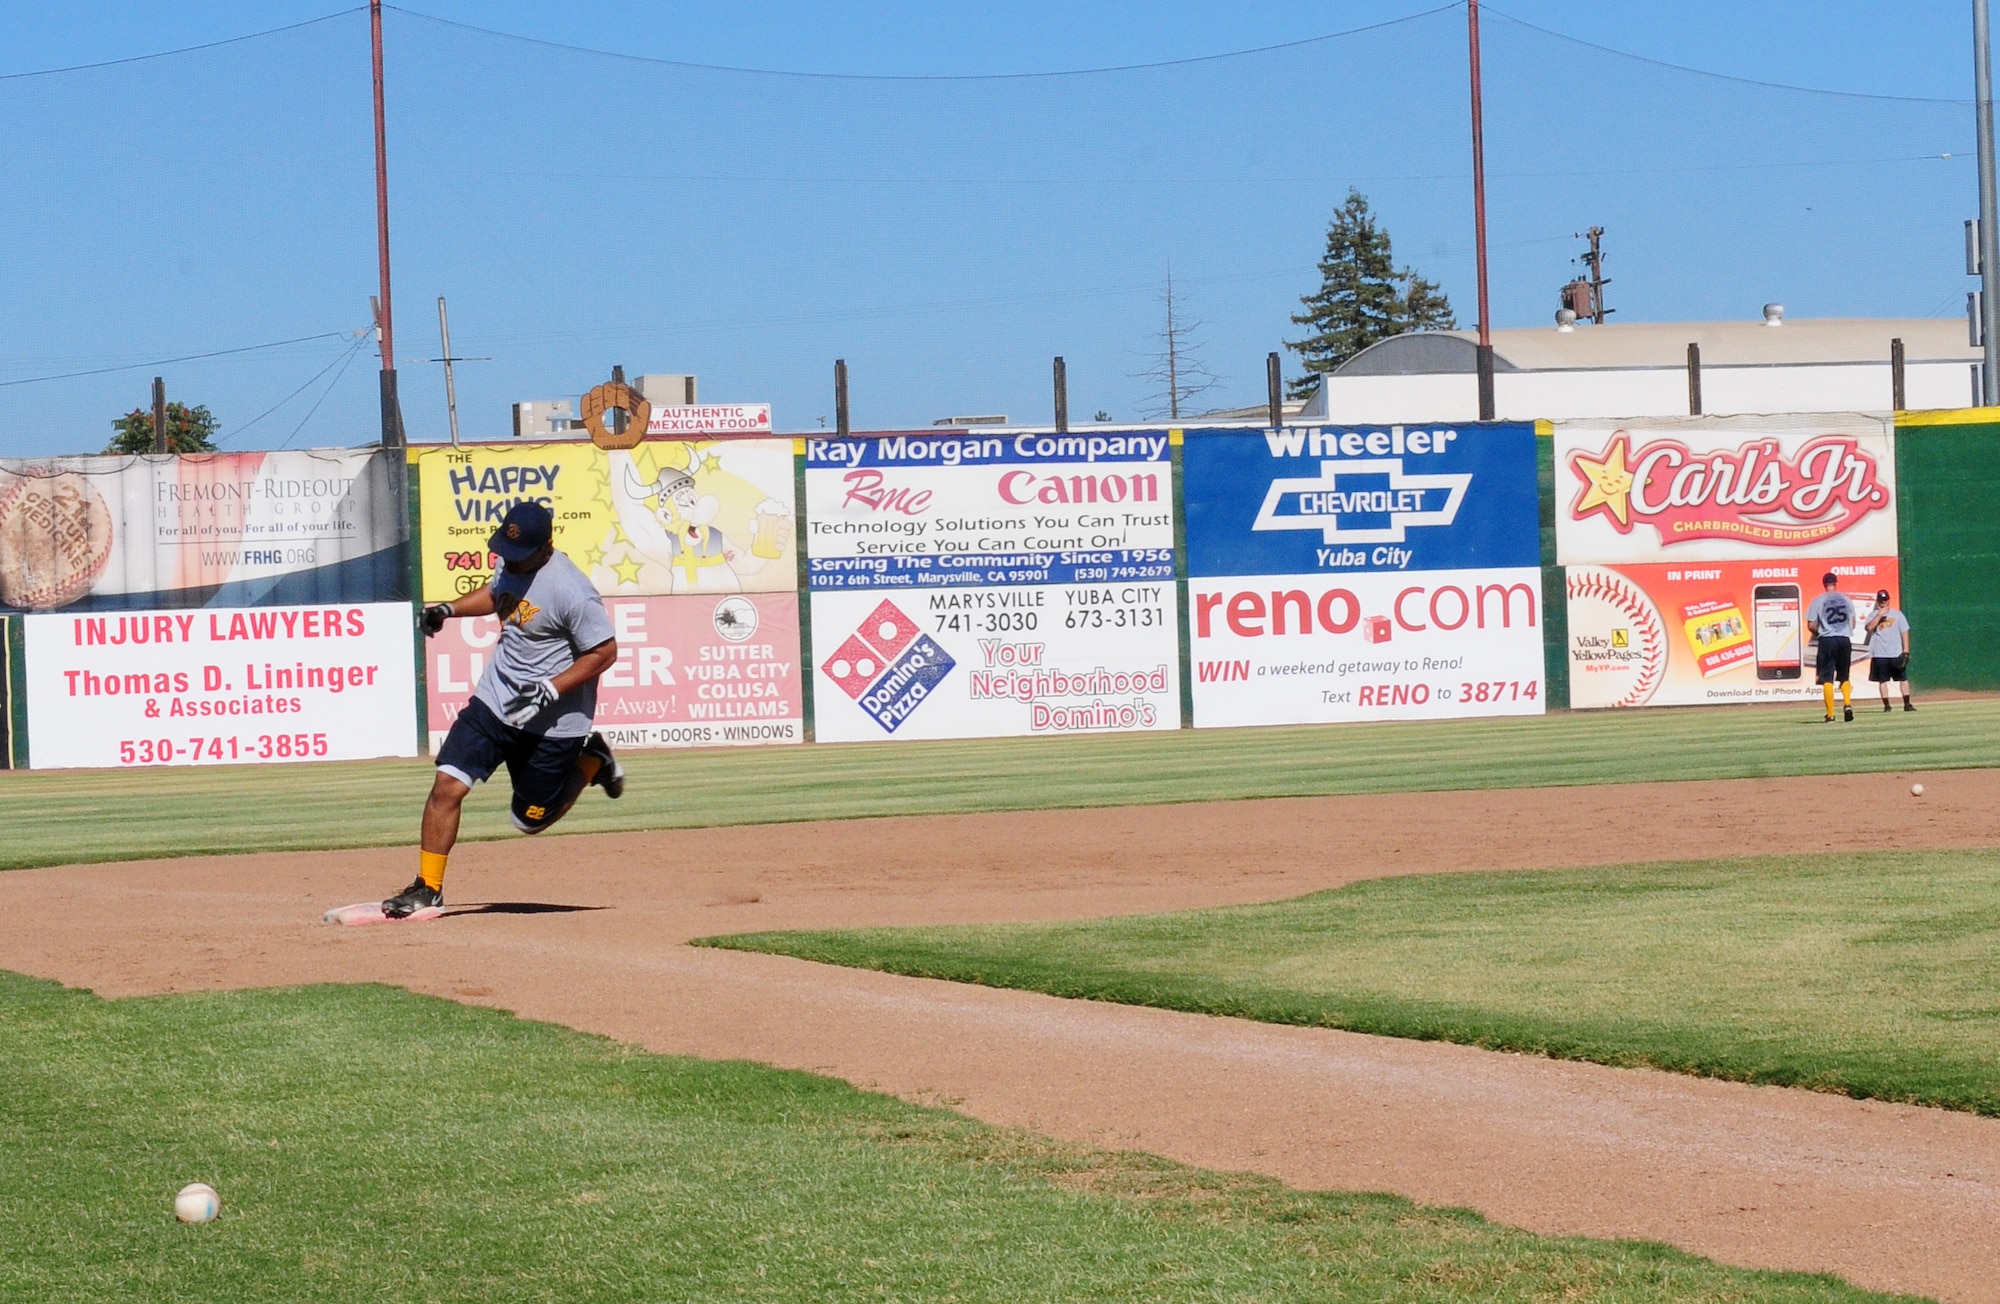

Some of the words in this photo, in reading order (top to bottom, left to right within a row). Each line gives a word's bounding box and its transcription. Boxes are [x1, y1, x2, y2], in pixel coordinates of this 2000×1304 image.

[662, 407, 744, 418] AUTHENTIC
[650, 420, 715, 430] MEXICAN
[720, 418, 757, 429] FOOD
[808, 439, 867, 468] Ray
[878, 436, 1002, 466] Morgan
[1014, 434, 1168, 462] Company
[1264, 427, 1457, 458] Wheeler
[446, 454, 472, 464] THE
[232, 465, 278, 476] THE
[449, 464, 560, 495] HAPPY
[1630, 443, 1790, 515] Carl's
[1792, 444, 1881, 512] Jr.
[158, 478, 355, 502] FREMONT-RIDEOUT
[998, 470, 1158, 505] Canon
[158, 504, 252, 518] HEALTH
[274, 501, 356, 514] GROUP
[455, 496, 555, 523] VIKI
[1299, 490, 1425, 514] CHEVROLET
[26, 492, 93, 556] CENTURY
[558, 510, 591, 520] .com
[810, 520, 927, 536] Technology
[935, 517, 1026, 531] Solutions
[1034, 516, 1069, 529] You
[1078, 515, 1114, 528] Can
[1122, 514, 1170, 526] Trust
[17, 502, 83, 570] MEDICINE
[158, 526, 178, 536] For
[182, 526, 198, 536] all
[201, 524, 212, 534] of
[216, 526, 241, 537] you.
[245, 524, 264, 533] For
[268, 522, 284, 532] all
[287, 522, 298, 532] of
[302, 524, 329, 535] your
[332, 520, 356, 530] life.
[448, 526, 486, 537] Sports
[1672, 520, 1771, 538] CHARBROILED
[1773, 524, 1836, 540] BURGERS
[856, 540, 926, 554] Service
[934, 539, 969, 552] You
[978, 538, 1015, 551] Can
[1024, 536, 1084, 550] Count
[202, 548, 315, 566] WWW.FRHG.ORG
[444, 551, 482, 570] 741
[811, 557, 888, 572] Serving
[894, 556, 932, 569] The
[938, 552, 1054, 569] Community
[1060, 552, 1113, 565] Since
[1121, 550, 1171, 562] 1956
[1316, 548, 1366, 568] Yuba
[1372, 546, 1413, 569] City
[811, 574, 844, 586] 1012
[848, 574, 870, 585] 6th
[873, 573, 914, 585] Street,
[917, 572, 984, 584] Marysville,
[987, 571, 1006, 582] CA
[1009, 570, 1049, 581] 95901
[1074, 568, 1108, 582] (530)
[1112, 566, 1172, 578] 749-2679
[1667, 570, 1682, 581] IN
[1684, 570, 1722, 580] PRINT
[1752, 567, 1799, 579] MOBILE
[1830, 566, 1876, 576] ONLINE
[455, 575, 492, 596] 67
[929, 592, 1045, 610] MARYSVILLE
[1065, 589, 1115, 606] YUBA
[1121, 588, 1162, 604] CITY
[935, 612, 1038, 633] 741-3030
[1065, 608, 1163, 629] 673-3131
[1825, 605, 1847, 624] 25
[74, 614, 195, 647] INJURY
[209, 608, 365, 641] LAWYERS
[1576, 636, 1610, 648] Valley
[699, 644, 774, 662] SUTTER
[978, 638, 1045, 668] Your
[684, 664, 742, 681] YUBA
[746, 662, 791, 678] CITY
[1198, 660, 1250, 682] WIN
[1257, 666, 1266, 676] a
[1270, 660, 1335, 676] weekend
[1338, 661, 1401, 678] getaway
[1404, 660, 1418, 672] to
[1422, 656, 1464, 670] Reno!
[1586, 664, 1630, 672] MyYP.com
[64, 670, 190, 697] Thomas
[203, 665, 232, 692] D.
[246, 662, 379, 694] Lininger
[862, 643, 934, 715] Domino's
[970, 664, 1168, 704] Neighborhood
[697, 682, 780, 700] COLUSA
[1322, 690, 1351, 703] Text
[1358, 684, 1430, 706] RENO
[1437, 688, 1452, 700] to
[1458, 680, 1538, 703] 38714
[1706, 689, 1752, 698] Download
[1772, 688, 1802, 696] iPhone
[1805, 687, 1822, 696] App
[144, 698, 161, 718] &
[170, 695, 302, 717] Associates
[613, 695, 676, 719] Away!
[688, 700, 790, 719] WILLIAMS
[878, 682, 928, 730] Pizza
[1031, 698, 1156, 731] Domino's
[608, 730, 648, 744] PAINT
[660, 727, 712, 743] DOORS
[724, 724, 794, 740] WINDOWS
[120, 732, 328, 764] 530-741-3855
